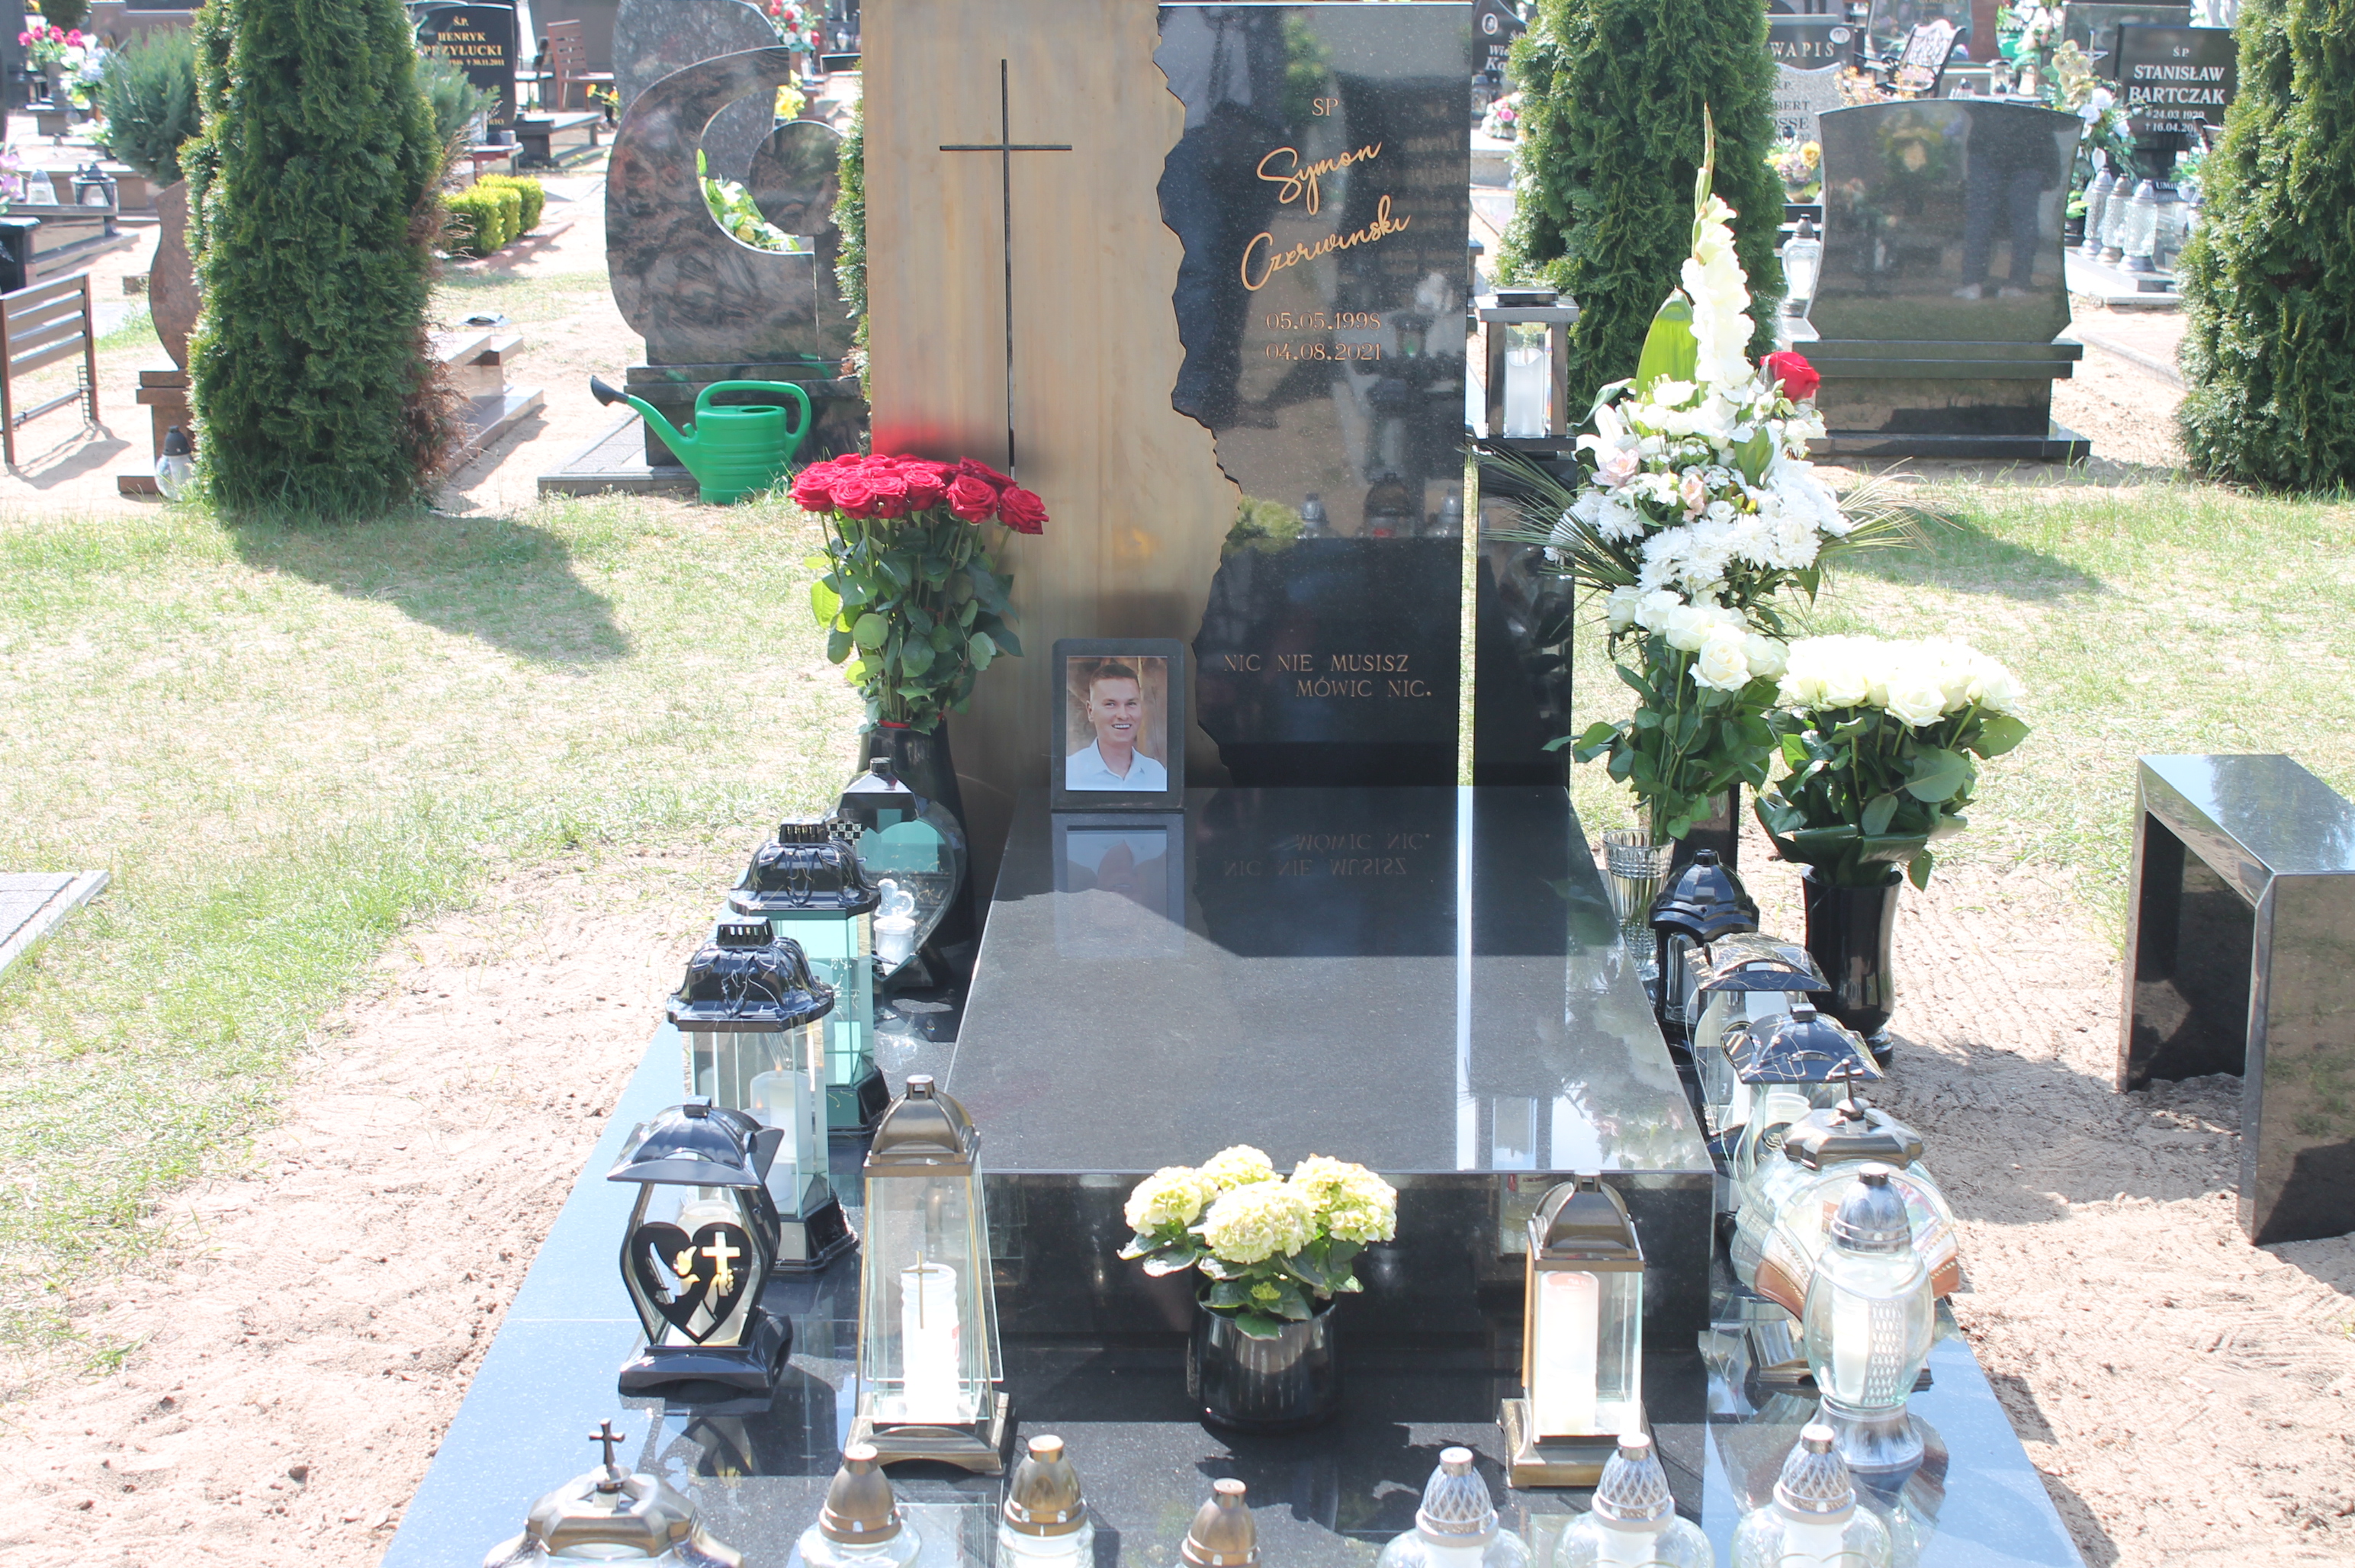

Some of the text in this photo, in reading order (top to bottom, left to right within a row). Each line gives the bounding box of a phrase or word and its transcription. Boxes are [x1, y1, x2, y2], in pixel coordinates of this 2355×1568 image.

[437, 32, 486, 41] HENRYK
[1769, 41, 1835, 58] WAPIS
[2134, 64, 2225, 82] STANISŁAW
[2128, 85, 2225, 105] BARTCZAK
[1266, 312, 1381, 330] 05.05.1998
[1265, 342, 1382, 361] 04.08.2021
[1223, 654, 1409, 672] NIC NIE MUSISZ
[1387, 680, 1432, 697] NIC.
